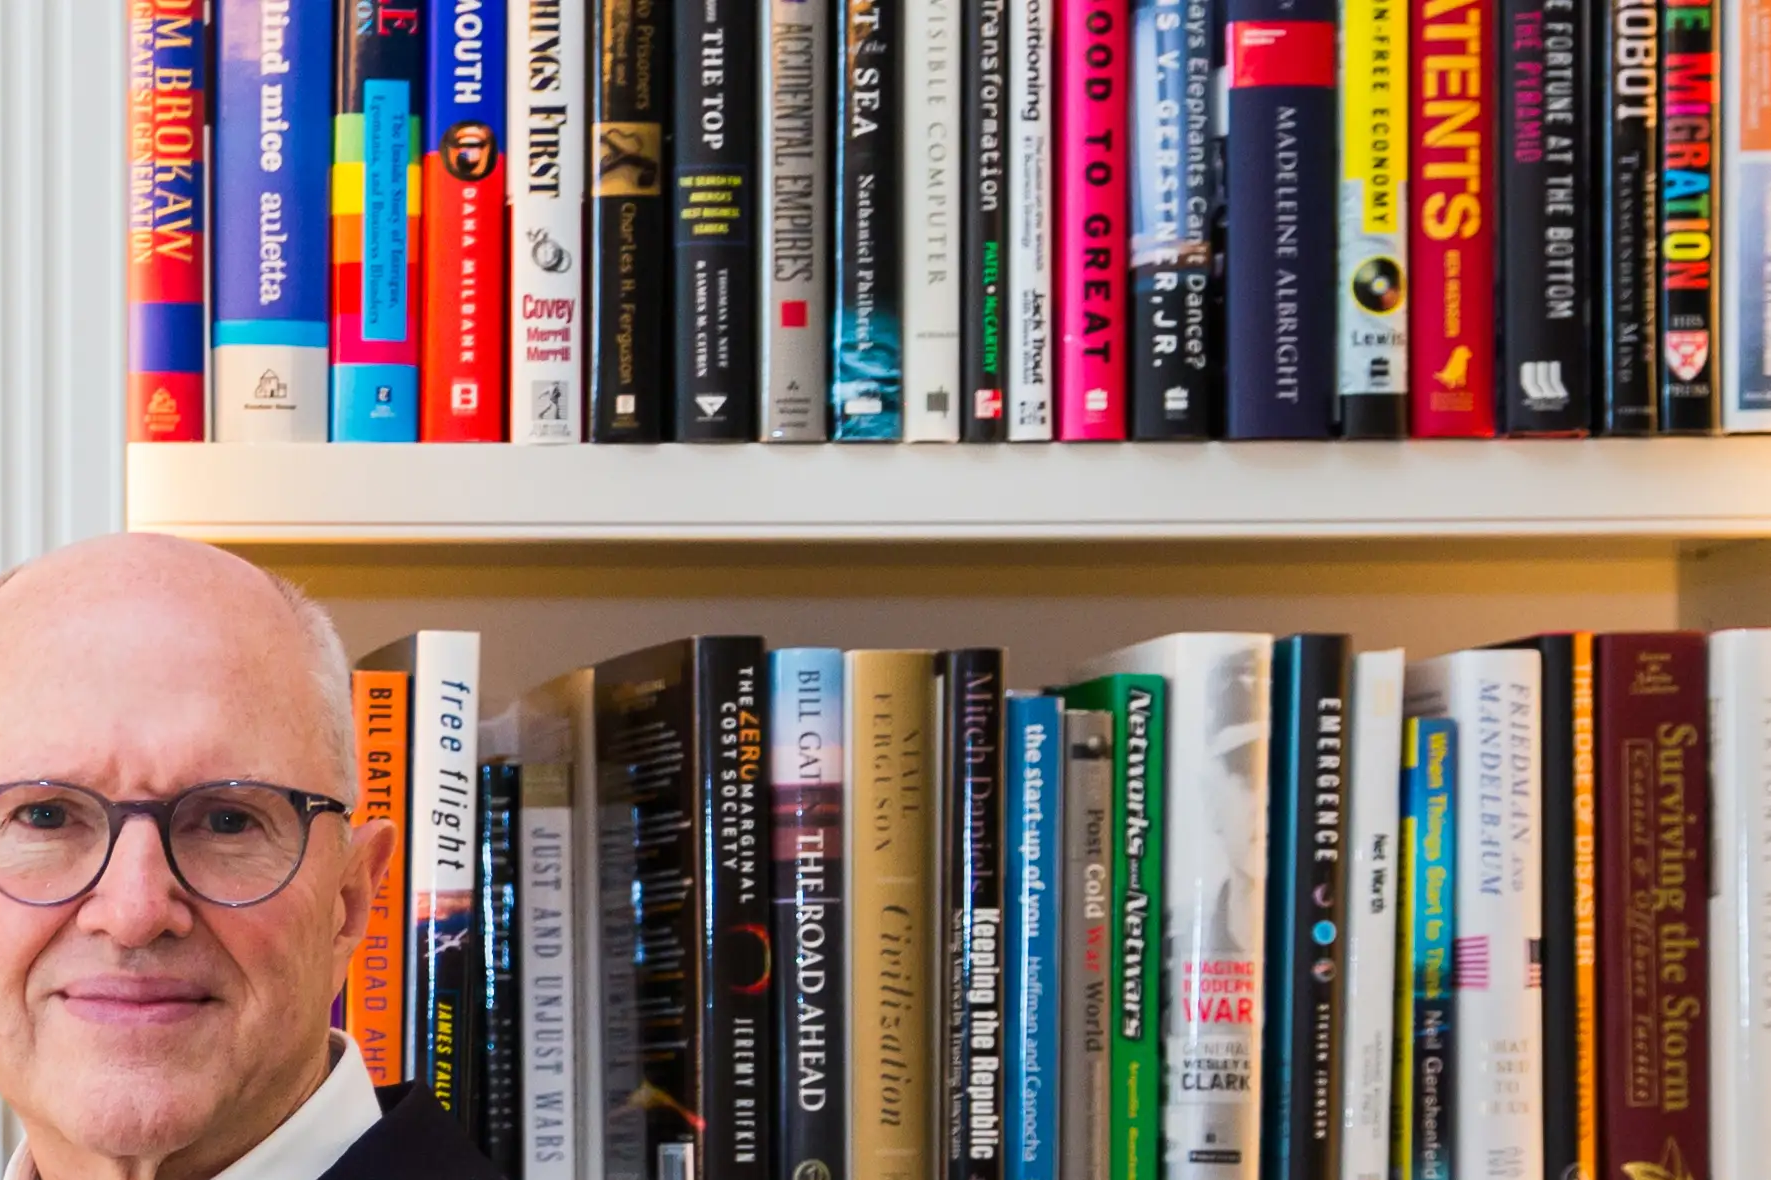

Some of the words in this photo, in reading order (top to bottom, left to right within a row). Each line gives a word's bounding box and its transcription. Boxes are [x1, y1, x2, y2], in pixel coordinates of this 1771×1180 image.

[1546, 22, 1573, 125] FORTUNE
[528, 104, 568, 197] FIRST
[1086, 130, 1112, 186] TO
[1276, 107, 1296, 259] MADELEINE
[1546, 135, 1573, 164] AT
[1546, 176, 1573, 215] THE
[260, 192, 287, 305] auletta
[463, 188, 477, 249] DANA
[773, 175, 814, 284] EMPIRES
[461, 260, 475, 363] MILBANK
[522, 295, 575, 323] Covey
[1084, 215, 1112, 362] GREAT
[1546, 227, 1573, 319] BOTTOM
[1276, 269, 1300, 402] ALBRIGHT
[439, 680, 470, 753] free
[432, 768, 469, 871] flight
[1126, 689, 1152, 858] Networks
[1315, 698, 1341, 862] EMERGENCE
[798, 830, 824, 892] THE
[798, 904, 825, 994] ROAD
[967, 907, 1000, 1005] Keeping
[734, 1017, 754, 1087] JEREMY
[798, 1002, 826, 1112] AHEAD
[970, 1010, 999, 1050] the
[967, 1056, 1000, 1160] Republic
[1182, 1073, 1252, 1091] CLARK
[736, 1100, 754, 1163] RIFKIN
